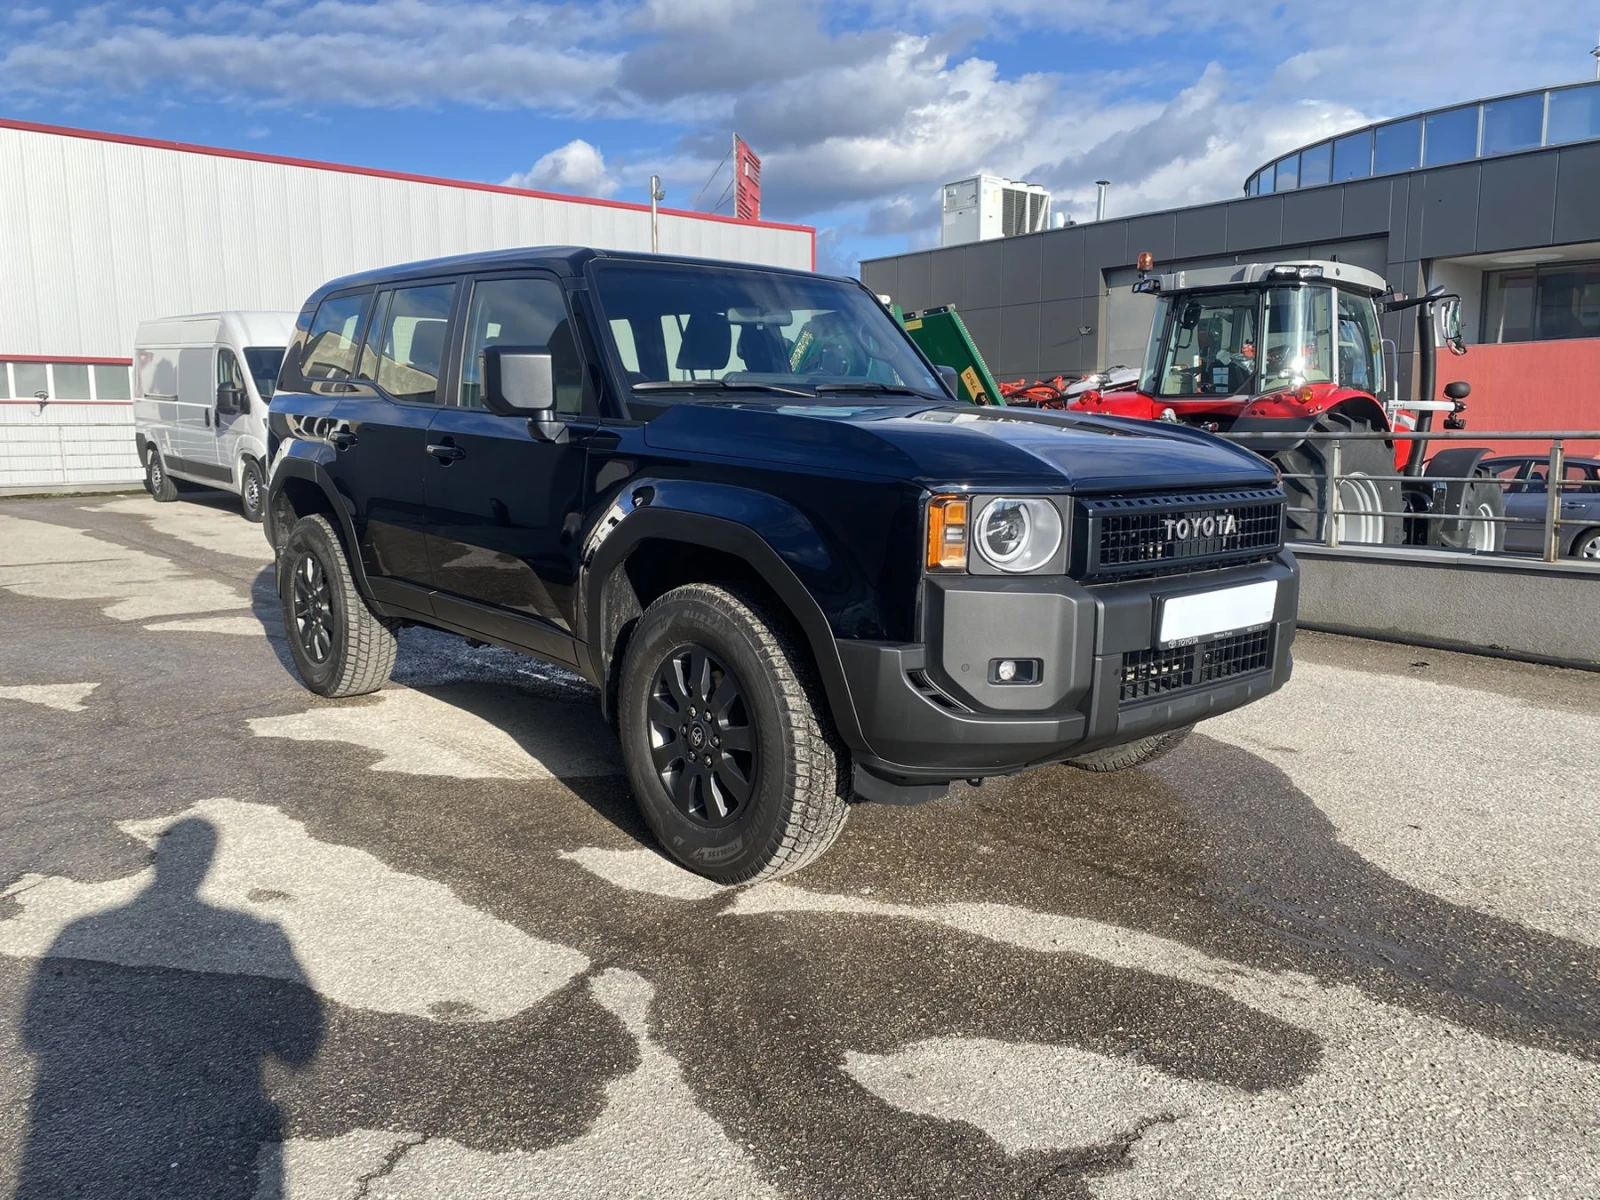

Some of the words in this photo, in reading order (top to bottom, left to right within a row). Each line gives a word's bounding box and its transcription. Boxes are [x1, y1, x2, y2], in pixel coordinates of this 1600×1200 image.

[1164, 514, 1237, 540] TOYOTA
[1178, 636, 1199, 647] TOYOTA
[707, 842, 738, 858] STUDLESS
